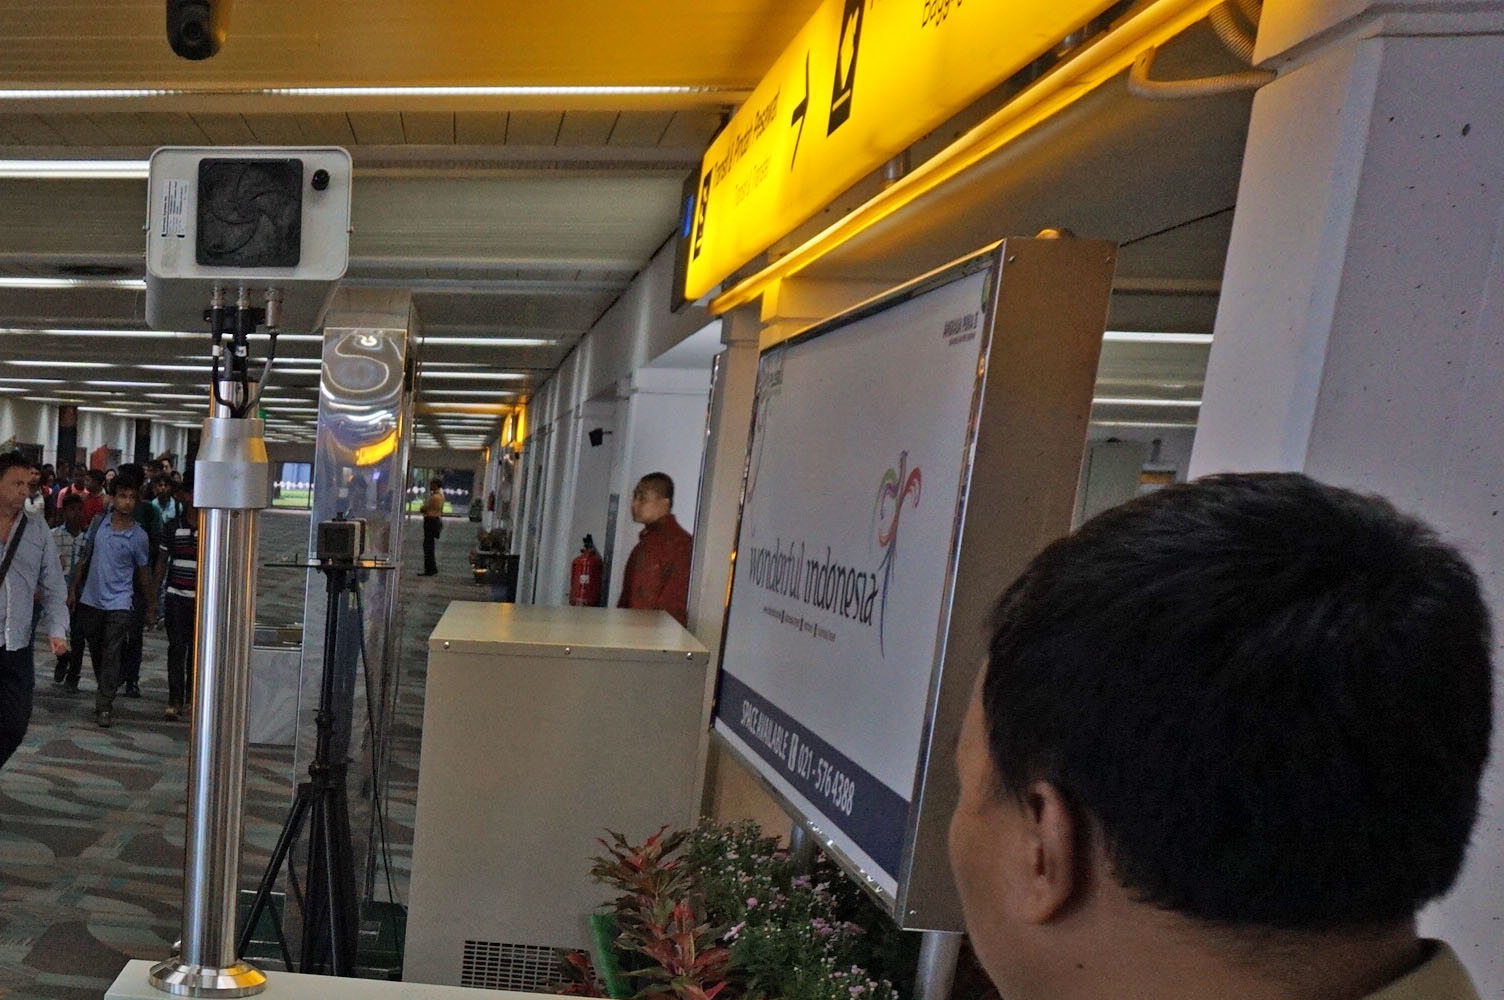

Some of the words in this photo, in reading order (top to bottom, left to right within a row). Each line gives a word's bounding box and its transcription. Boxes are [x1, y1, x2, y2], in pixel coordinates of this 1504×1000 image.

[749, 537, 805, 601] wonderful
[804, 546, 879, 627] indonesia
[741, 701, 758, 735] SPACE
[757, 712, 789, 760] AVAILABLE
[797, 743, 814, 781] 021
[814, 757, 834, 798] 576
